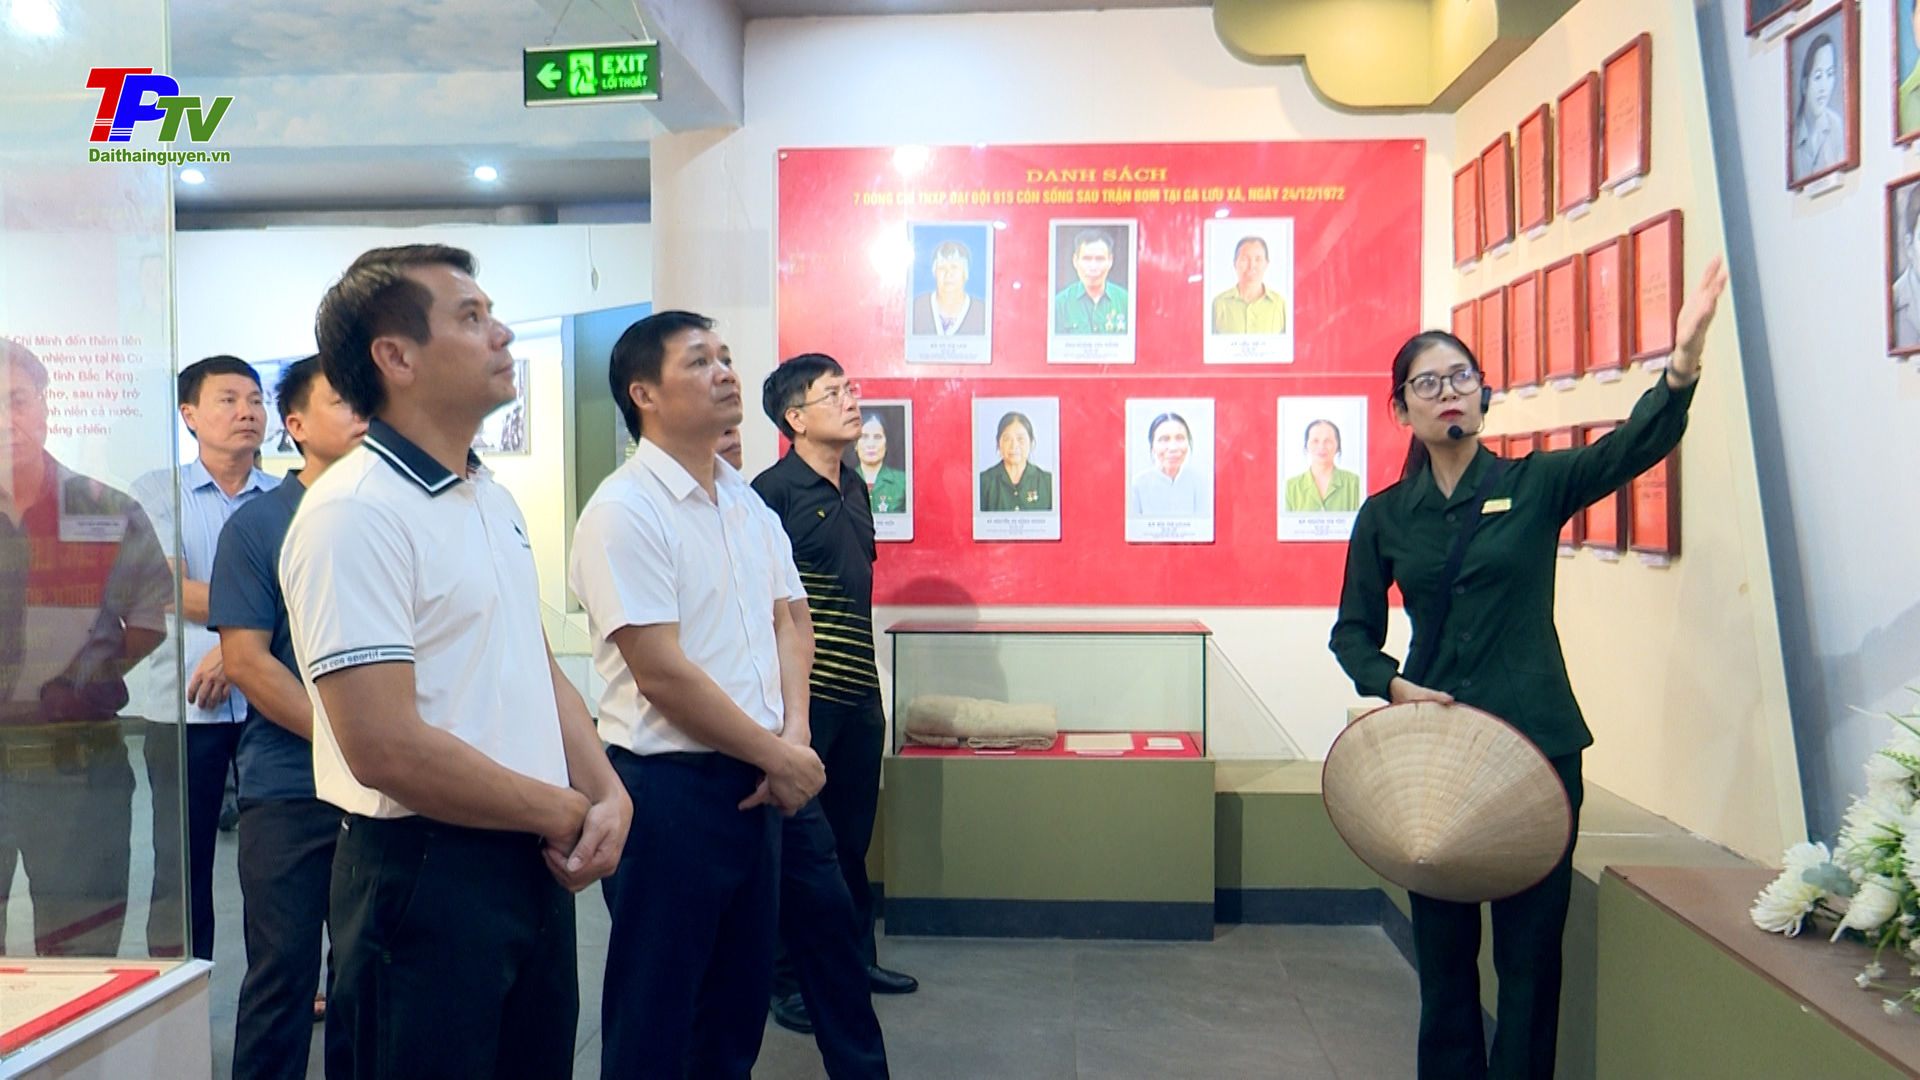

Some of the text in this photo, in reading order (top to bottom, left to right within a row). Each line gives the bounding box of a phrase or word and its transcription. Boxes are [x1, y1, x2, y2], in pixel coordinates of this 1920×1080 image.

[602, 54, 648, 74] EXIT
[1026, 165, 1168, 183] DANH SÁCH
[854, 191, 861, 206] 7
[993, 189, 1014, 205] 915
[1016, 188, 1040, 205] CÒN
[1043, 186, 1074, 205] SỐNG
[1076, 188, 1099, 204] SAU
[1102, 187, 1132, 206] TRẬN
[1134, 188, 1160, 203] BOM
[1163, 187, 1181, 205] TẠI
[1183, 187, 1199, 202] GA
[1227, 185, 1245, 203] XÁ,
[1248, 185, 1279, 201] NGÀY
[1281, 186, 1345, 201] 24/12/1972
[35, 335, 62, 346] Minh
[65, 333, 86, 346] đến
